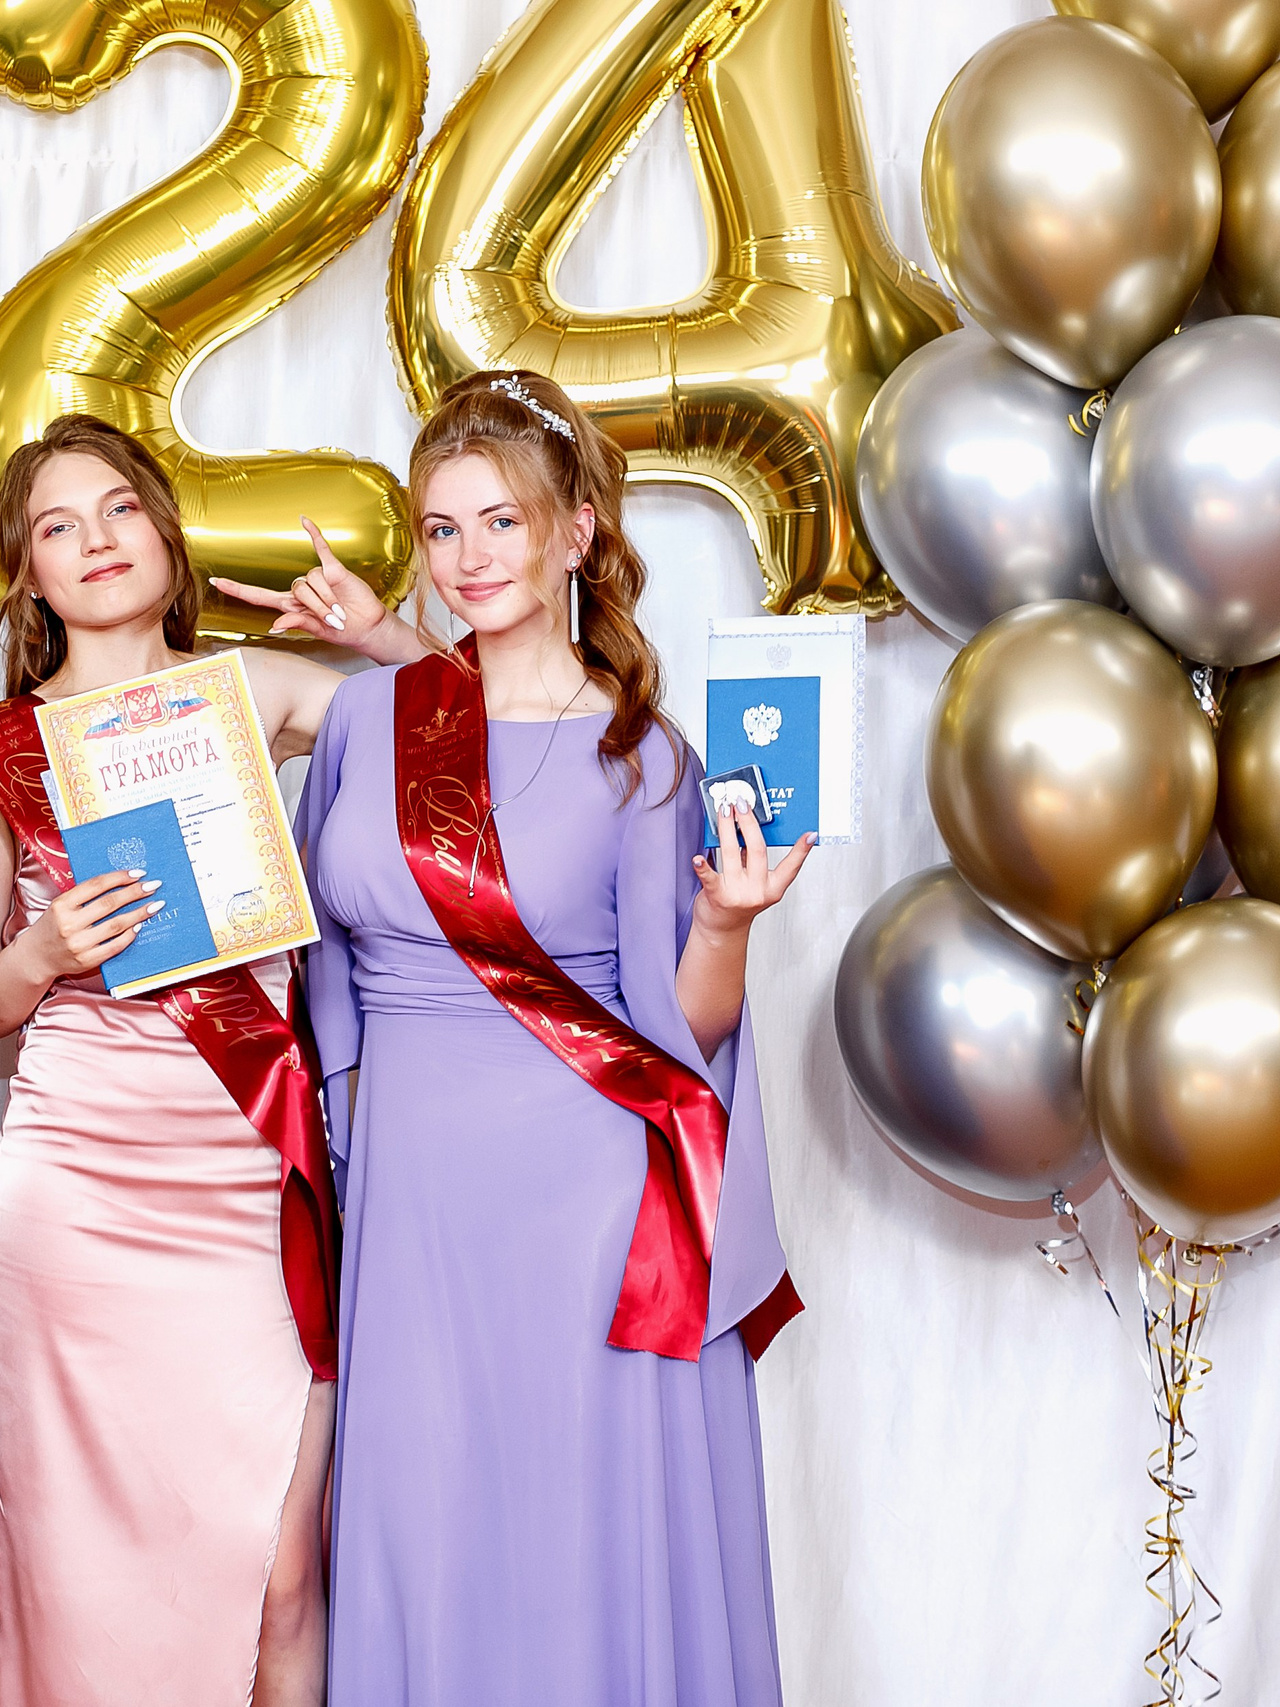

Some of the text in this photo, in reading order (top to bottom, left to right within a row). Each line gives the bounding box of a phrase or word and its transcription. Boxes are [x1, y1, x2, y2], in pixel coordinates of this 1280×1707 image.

[99, 737, 220, 792] ГРАМОТА
[142, 907, 180, 928] ЕСТАТ
[181, 976, 275, 1048] 2024
